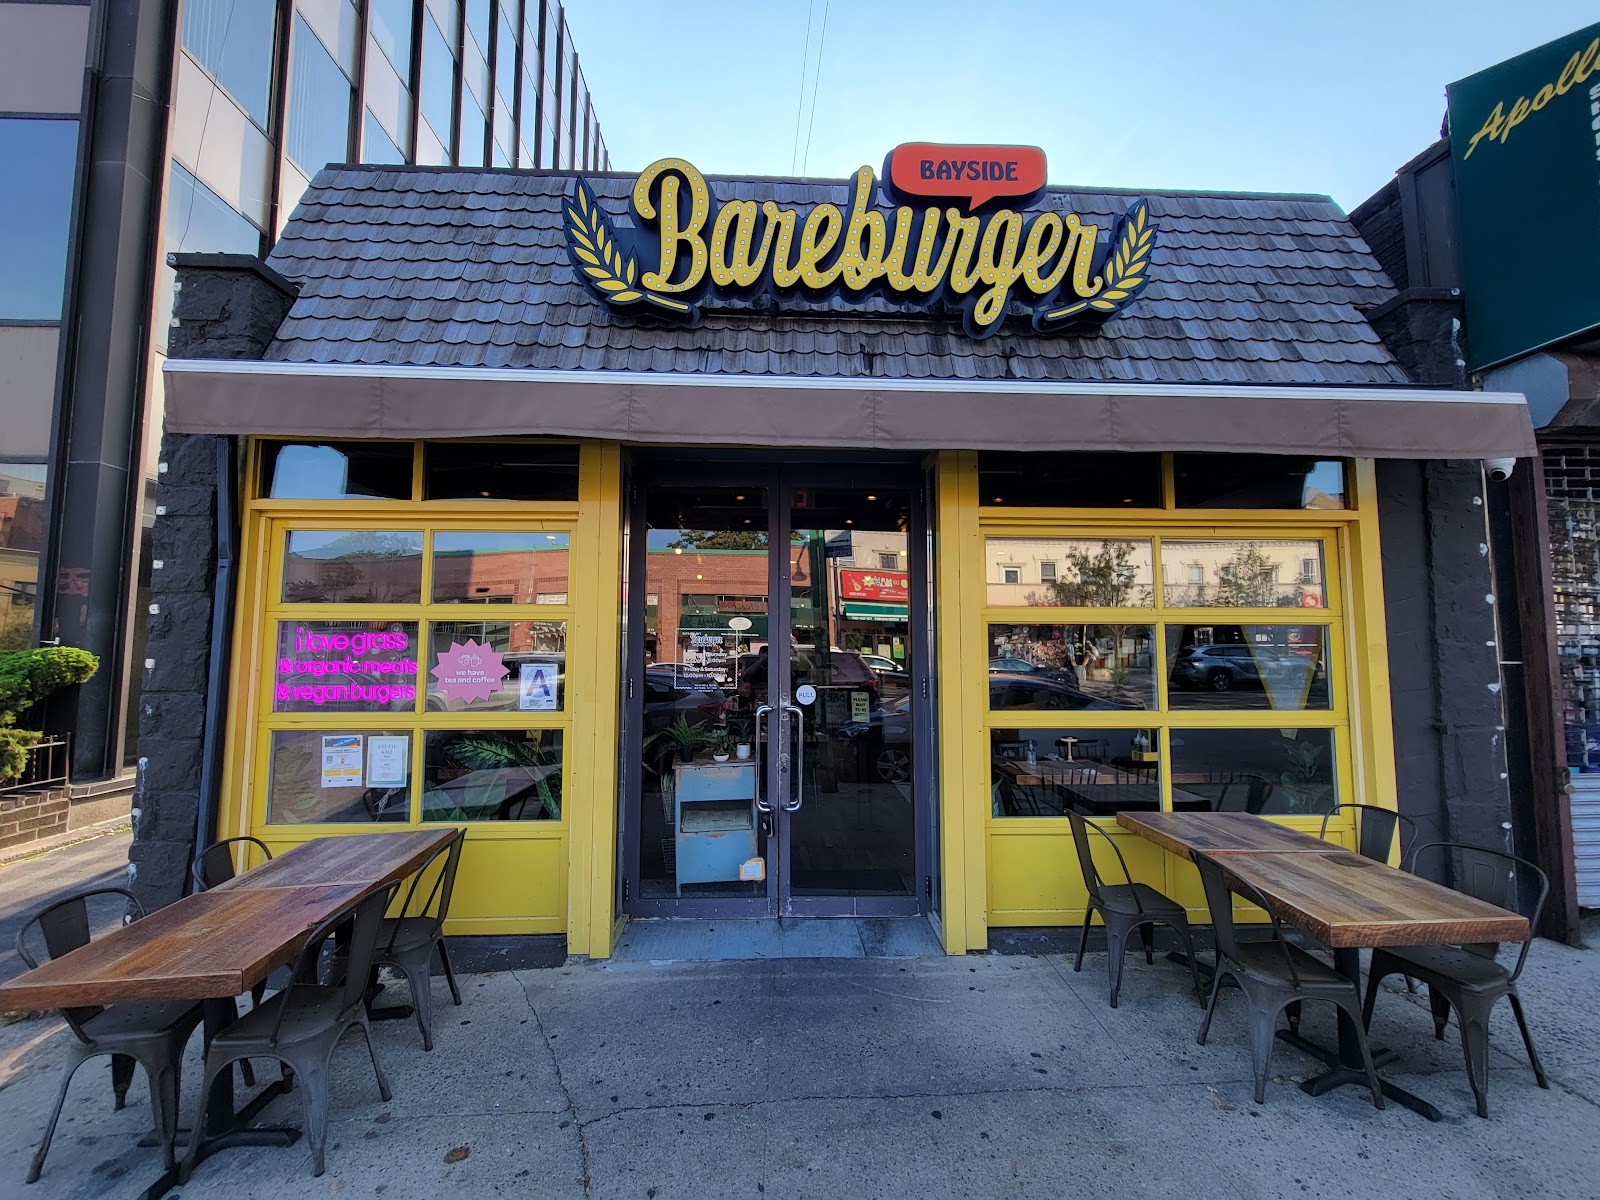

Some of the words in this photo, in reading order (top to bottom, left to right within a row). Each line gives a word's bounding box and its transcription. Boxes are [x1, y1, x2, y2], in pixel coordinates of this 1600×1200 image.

[1463, 37, 1600, 160] Apoll
[920, 159, 1019, 182] BAYSIDE
[633, 157, 1103, 327] Bareburger
[305, 631, 350, 652] love
[350, 632, 409, 656] grass
[280, 657, 293, 674] &
[296, 656, 361, 678] organic
[363, 659, 417, 674] meats
[277, 682, 289, 701] &
[290, 685, 347, 705] vegan
[350, 682, 416, 705] burgers
[526, 669, 551, 697] A
